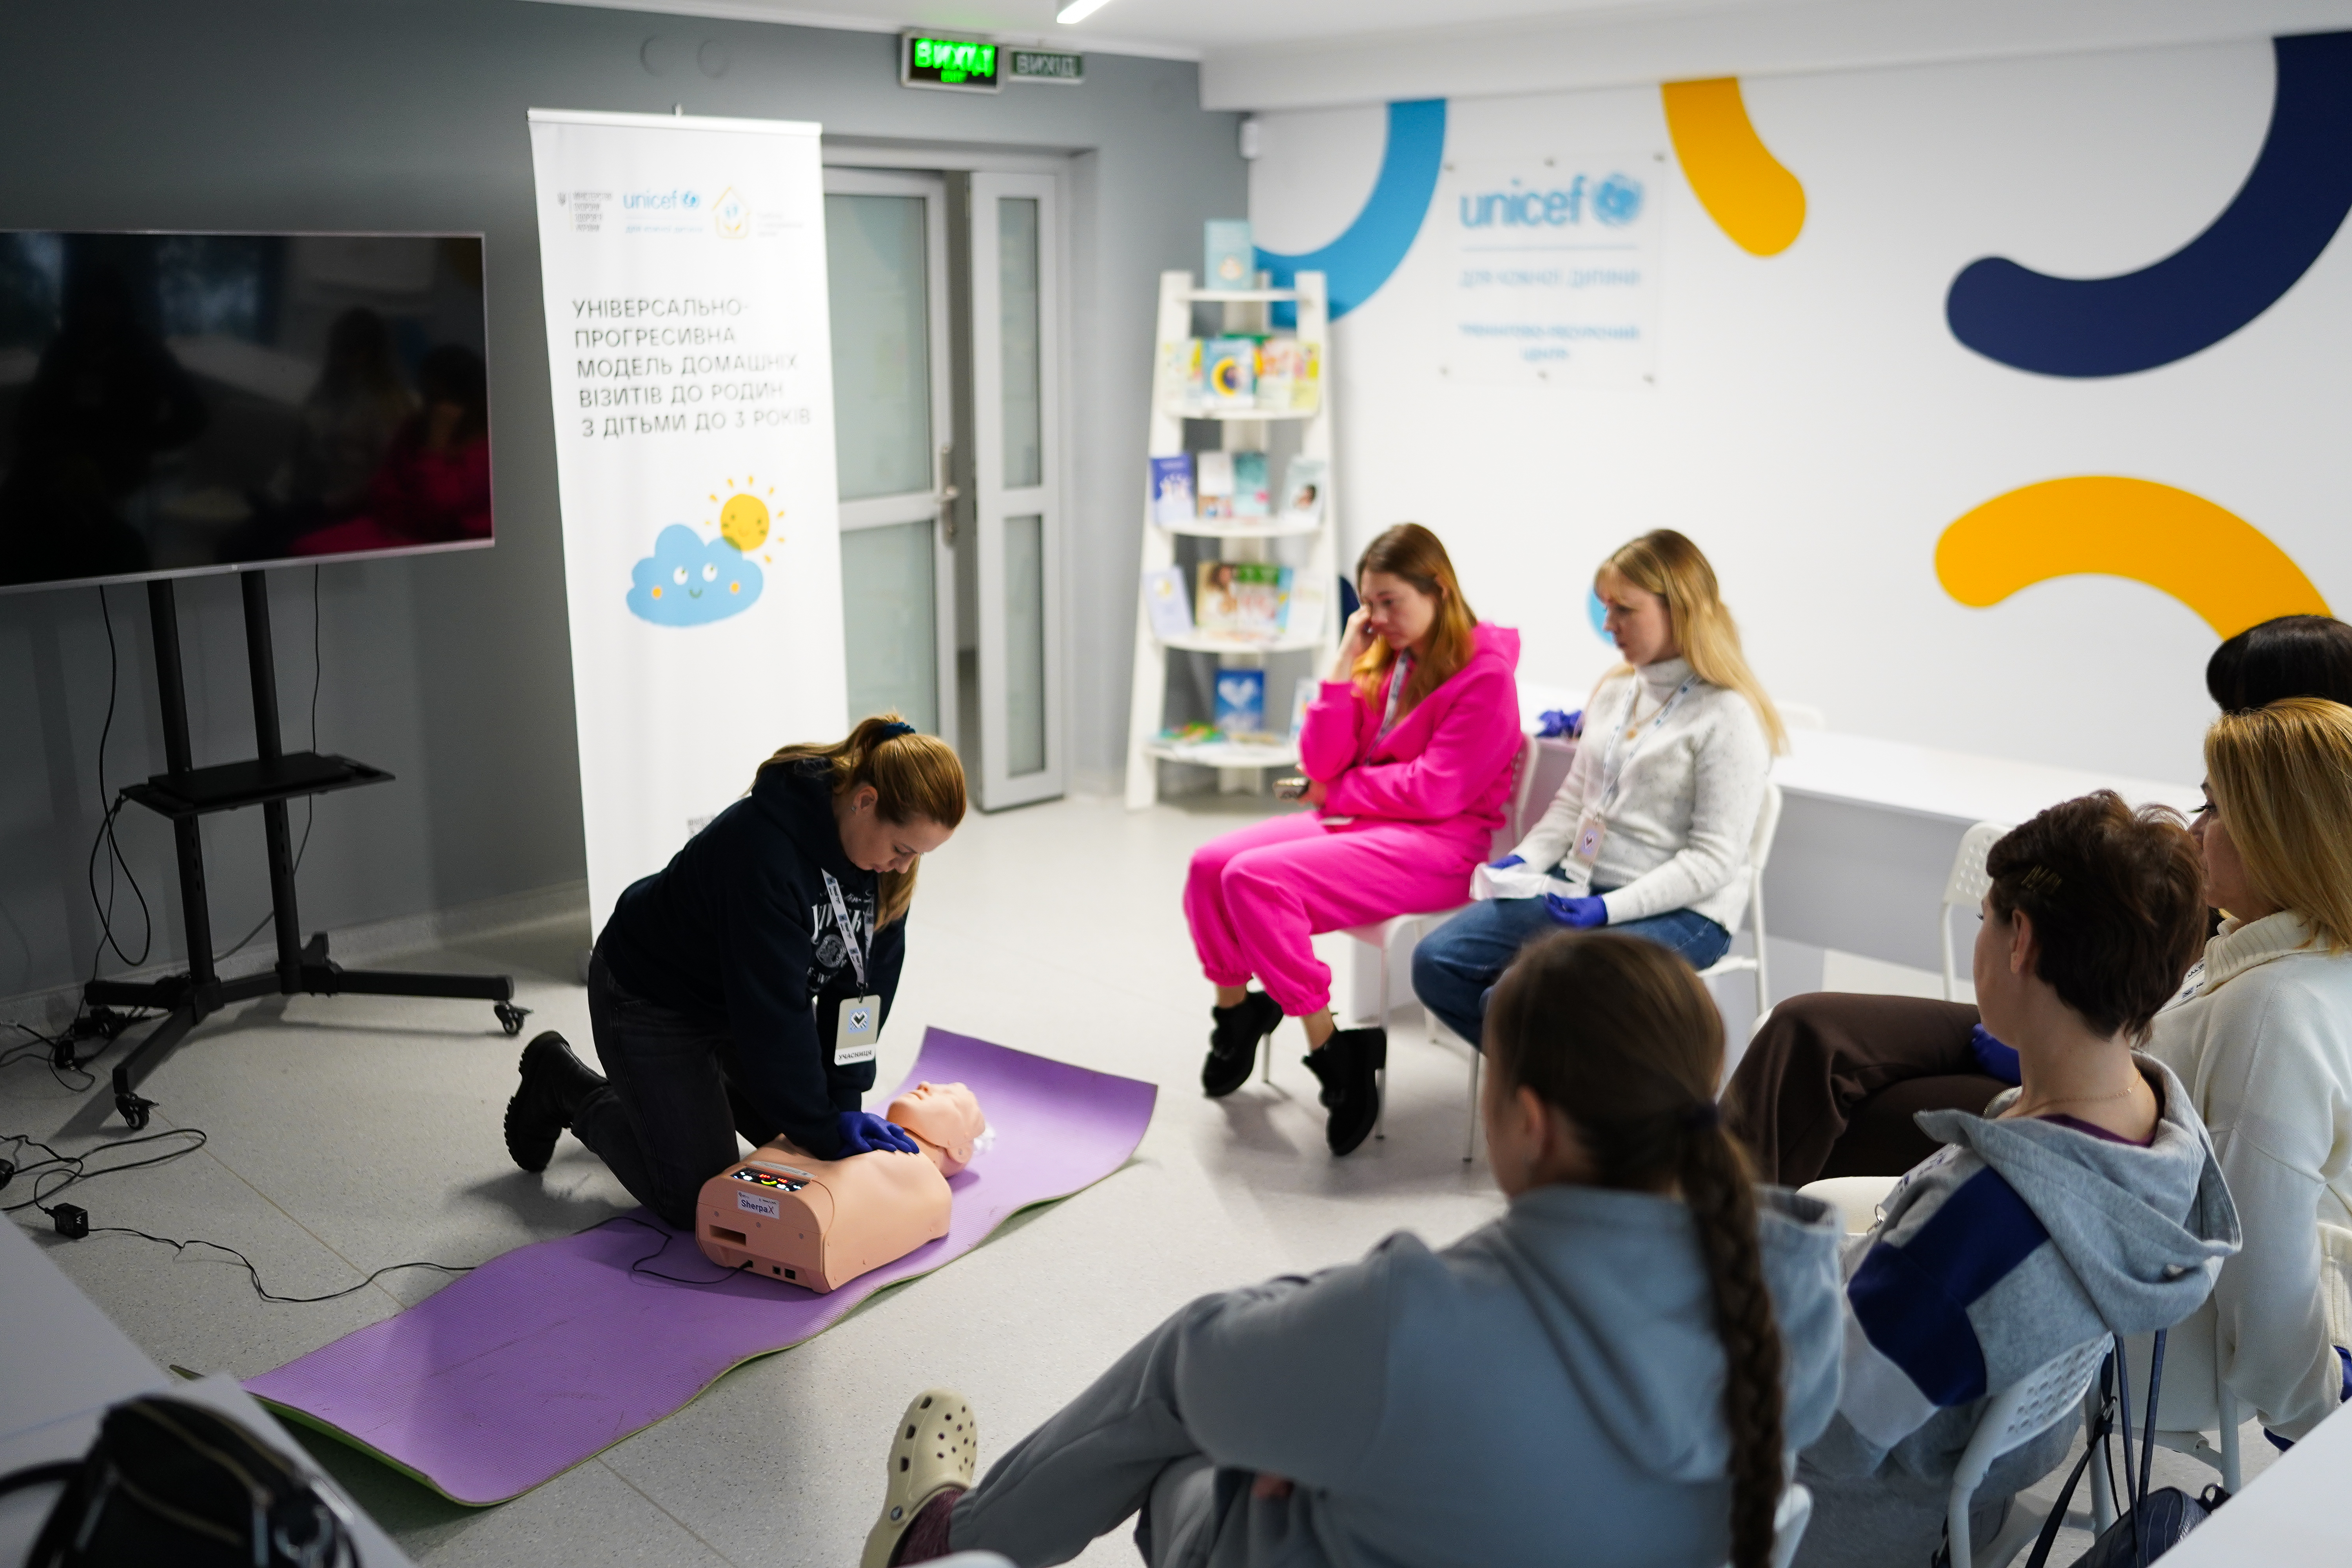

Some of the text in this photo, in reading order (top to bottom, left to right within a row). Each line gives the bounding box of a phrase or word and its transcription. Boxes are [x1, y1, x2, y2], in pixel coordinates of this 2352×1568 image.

[624, 190, 677, 209] unicef
[1459, 172, 1586, 228] unicef
[572, 299, 748, 318] УНІВЕРСАЛЬНО-
[575, 328, 735, 348] ПРОГРЕСИВНА
[577, 354, 799, 379] МОДЕЛЬ ДОМАШНІХ
[579, 383, 783, 408] ВІЗИТІВ ДО РОДИН
[603, 414, 687, 439] ДІТЬМИ
[695, 412, 726, 433] ДО
[753, 408, 812, 427] РОКІВ
[740, 1199, 775, 1215] SherpaX
